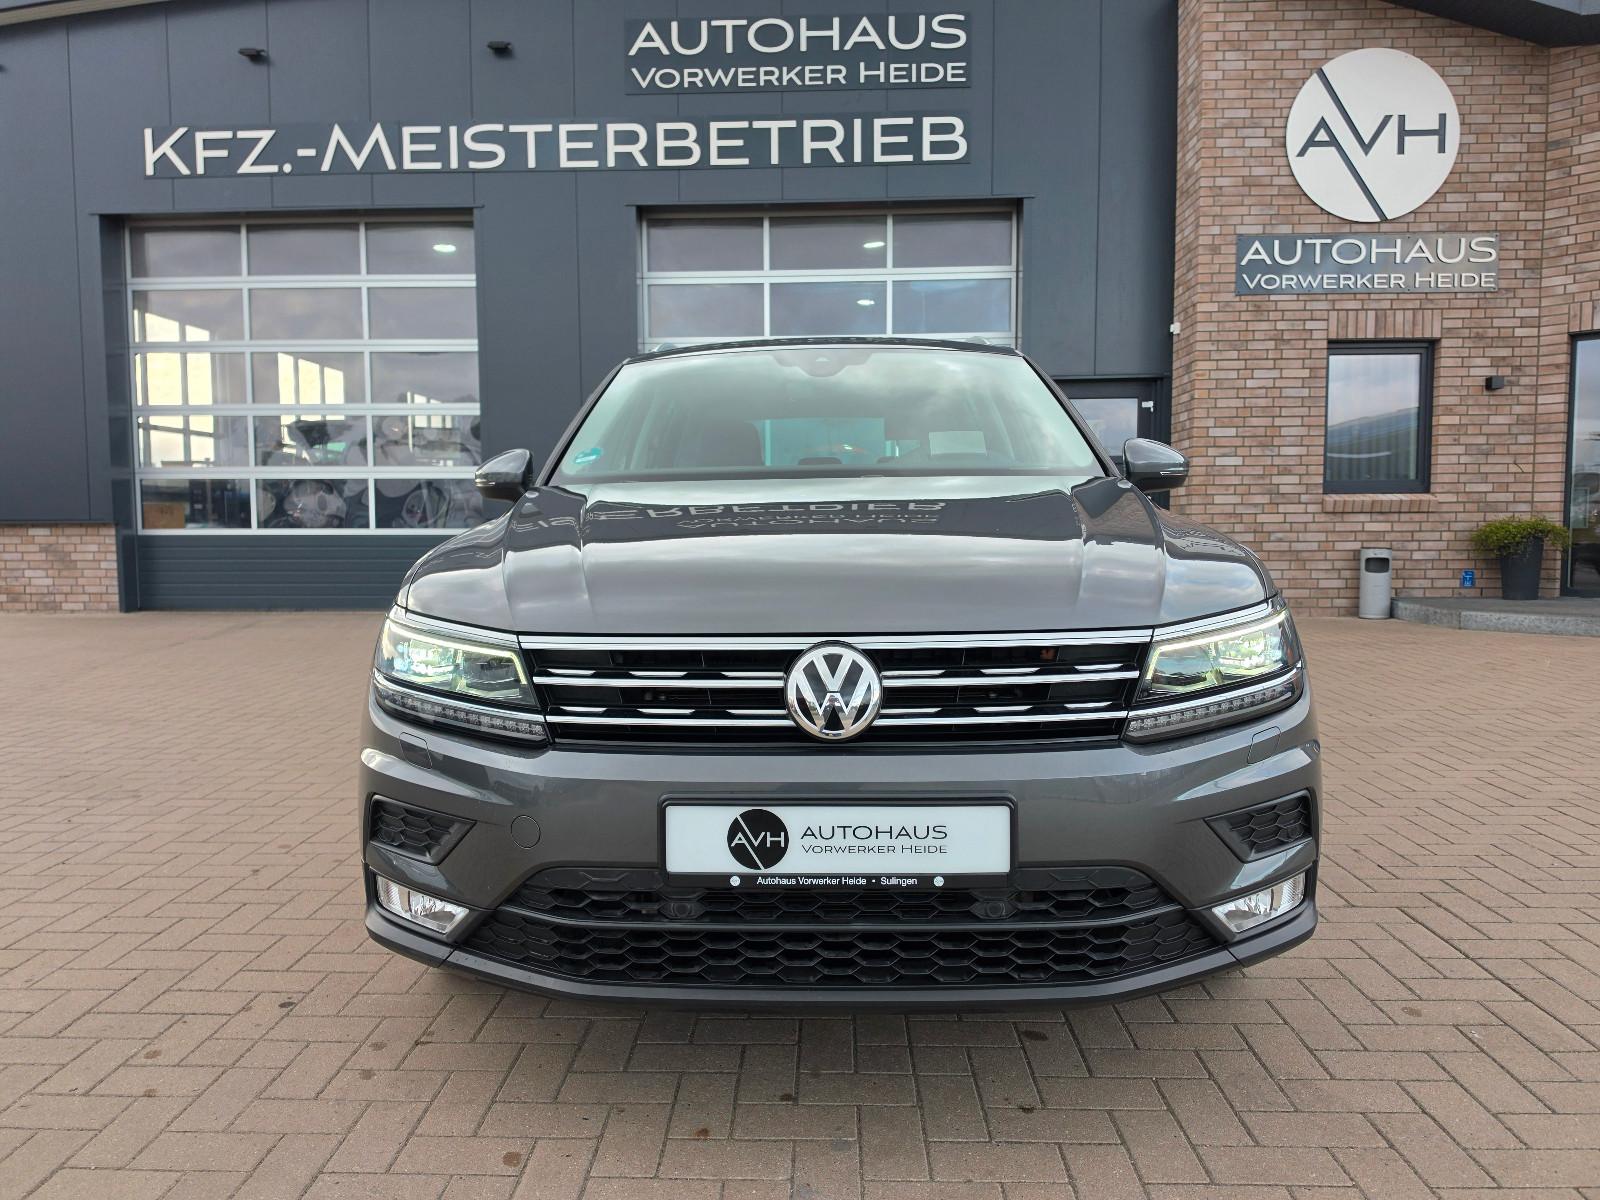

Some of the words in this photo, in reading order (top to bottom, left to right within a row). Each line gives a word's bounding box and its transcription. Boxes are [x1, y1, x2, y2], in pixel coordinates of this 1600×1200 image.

[628, 13, 967, 56] AUTOHAUS
[631, 65, 847, 89] VORWERKER
[859, 61, 967, 84] HEIDE
[1240, 237, 1498, 266] AUTOHAUS
[1242, 274, 1406, 290] VORWERKER
[1415, 272, 1496, 289] HEIDE
[788, 647, 881, 739] VW
[800, 825, 948, 840] AUTOHAUS
[801, 845, 896, 854] VORWERKER
[901, 845, 948, 854] HEIDE
[756, 876, 797, 886] Autohaus
[798, 876, 840, 886] Vorwerker
[842, 876, 867, 886] Heide
[880, 876, 918, 888] Sulingen
